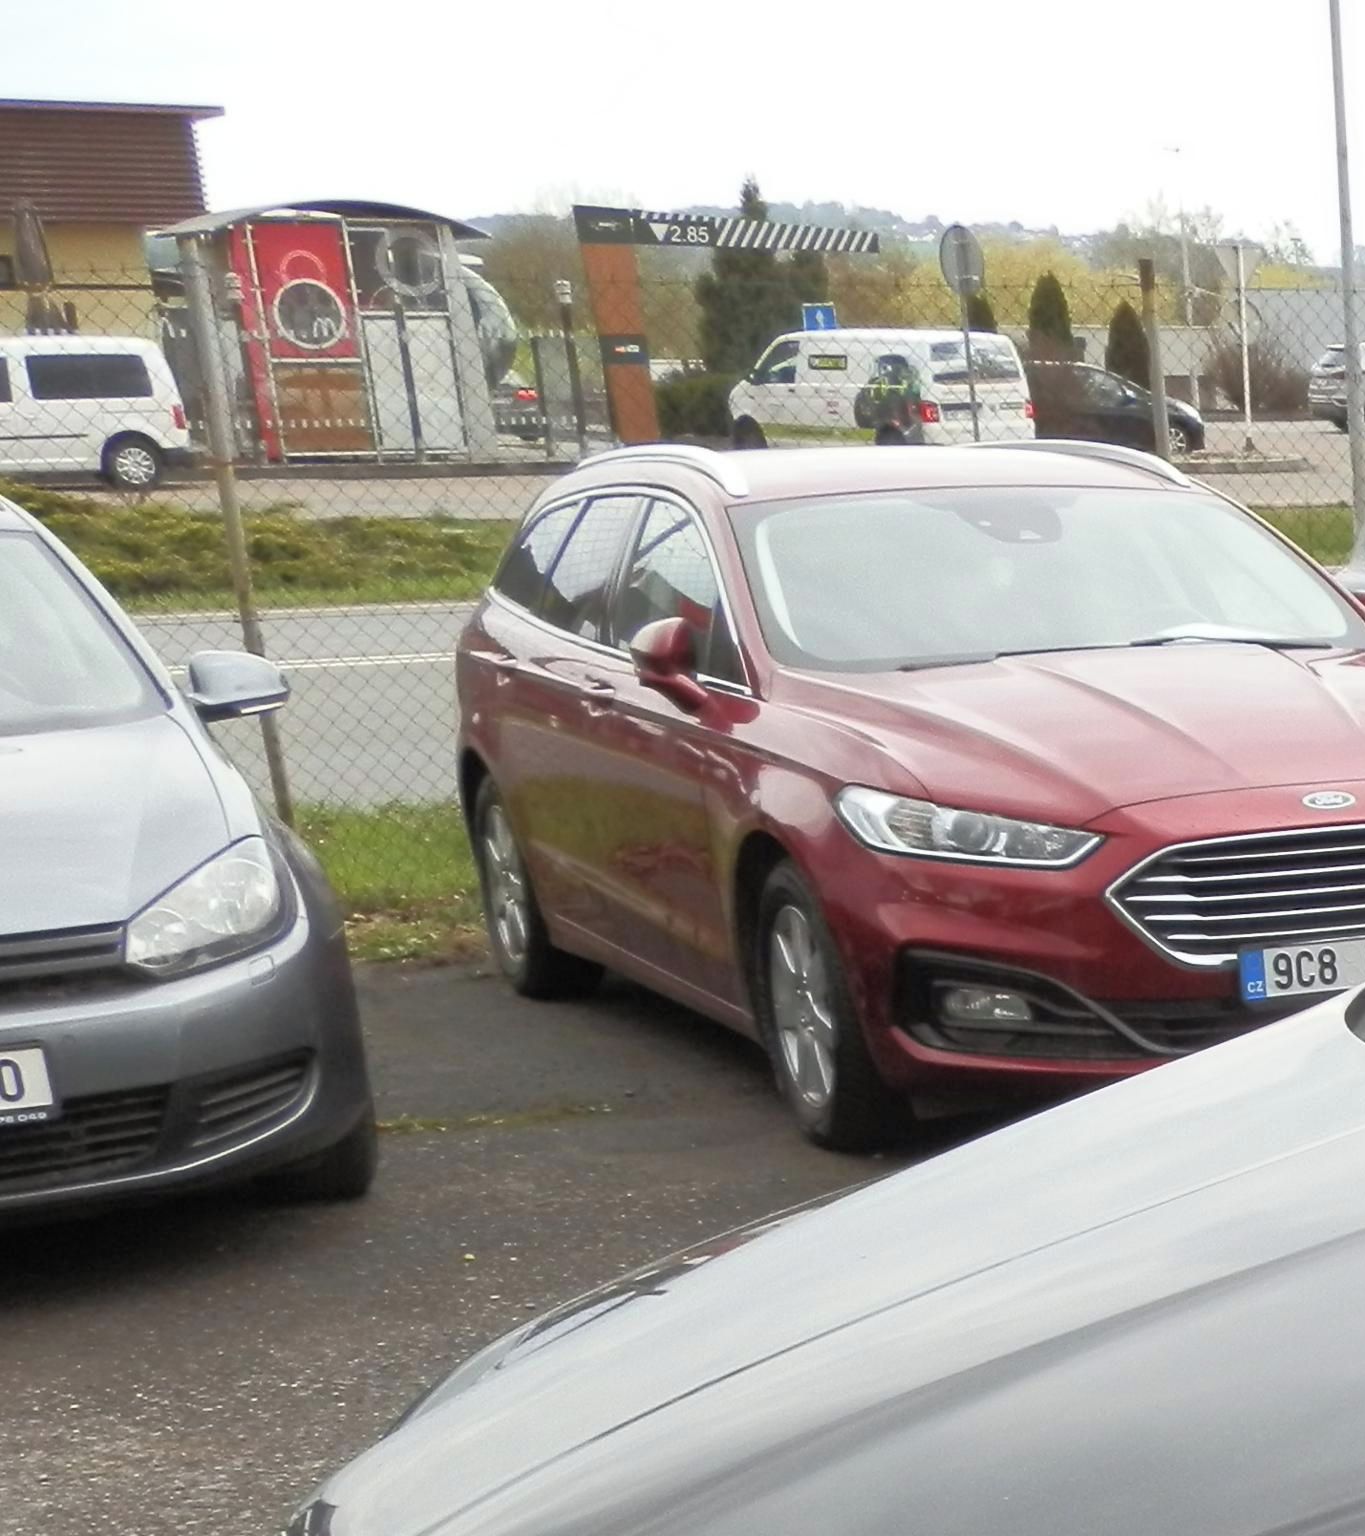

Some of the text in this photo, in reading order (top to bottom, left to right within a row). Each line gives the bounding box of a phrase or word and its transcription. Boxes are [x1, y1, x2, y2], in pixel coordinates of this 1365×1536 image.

[670, 225, 709, 243] 2.85
[1247, 981, 1264, 993] CZ
[1272, 948, 1338, 989] 9C8
